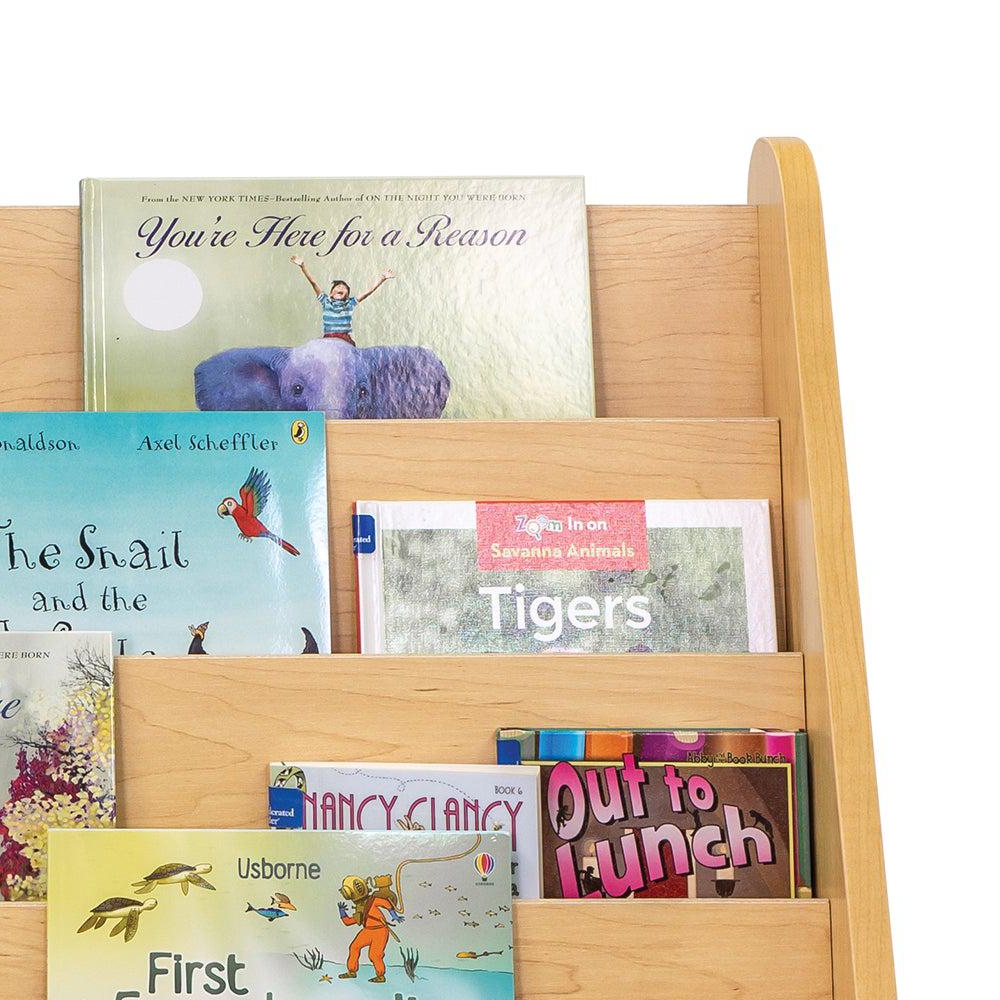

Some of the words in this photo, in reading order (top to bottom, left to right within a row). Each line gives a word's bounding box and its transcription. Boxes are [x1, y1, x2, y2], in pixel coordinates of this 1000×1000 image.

[141, 194, 164, 202] From
[166, 194, 179, 202] the
[182, 194, 205, 202] NEW
[208, 194, 236, 202] YORK
[323, 194, 352, 202] Author
[355, 194, 364, 202] of
[366, 194, 380, 202] ON
[384, 194, 403, 202] THE
[407, 194, 440, 202] NIGHT
[443, 194, 463, 202] YOU
[467, 194, 496, 202] WERE
[136, 216, 238, 258] You're
[245, 217, 326, 248] Here
[316, 216, 372, 257] for
[381, 228, 402, 247] a
[406, 214, 528, 248] Reason
[136, 433, 181, 452] Axel
[189, 433, 279, 452] Scheffler
[567, 516, 584, 531] In
[587, 520, 608, 531] on
[75, 523, 190, 571] Snail
[491, 543, 562, 558] Savanna
[567, 542, 635, 558] Animals
[32, 582, 89, 612] and
[99, 586, 148, 612] the
[478, 583, 652, 643] Tigers
[20, 651, 50, 660] BORN
[687, 752, 714, 768] Abby
[727, 752, 753, 764] Book
[755, 752, 787, 764] Bunch
[494, 785, 516, 795] BOOK
[517, 786, 523, 795] 6
[545, 753, 648, 842] Out
[662, 763, 718, 813] to
[303, 792, 398, 830] NANCY
[407, 796, 523, 852] CLANCY
[556, 804, 776, 899] Lunch
[237, 858, 321, 880] Usborne
[148, 952, 249, 995] First
